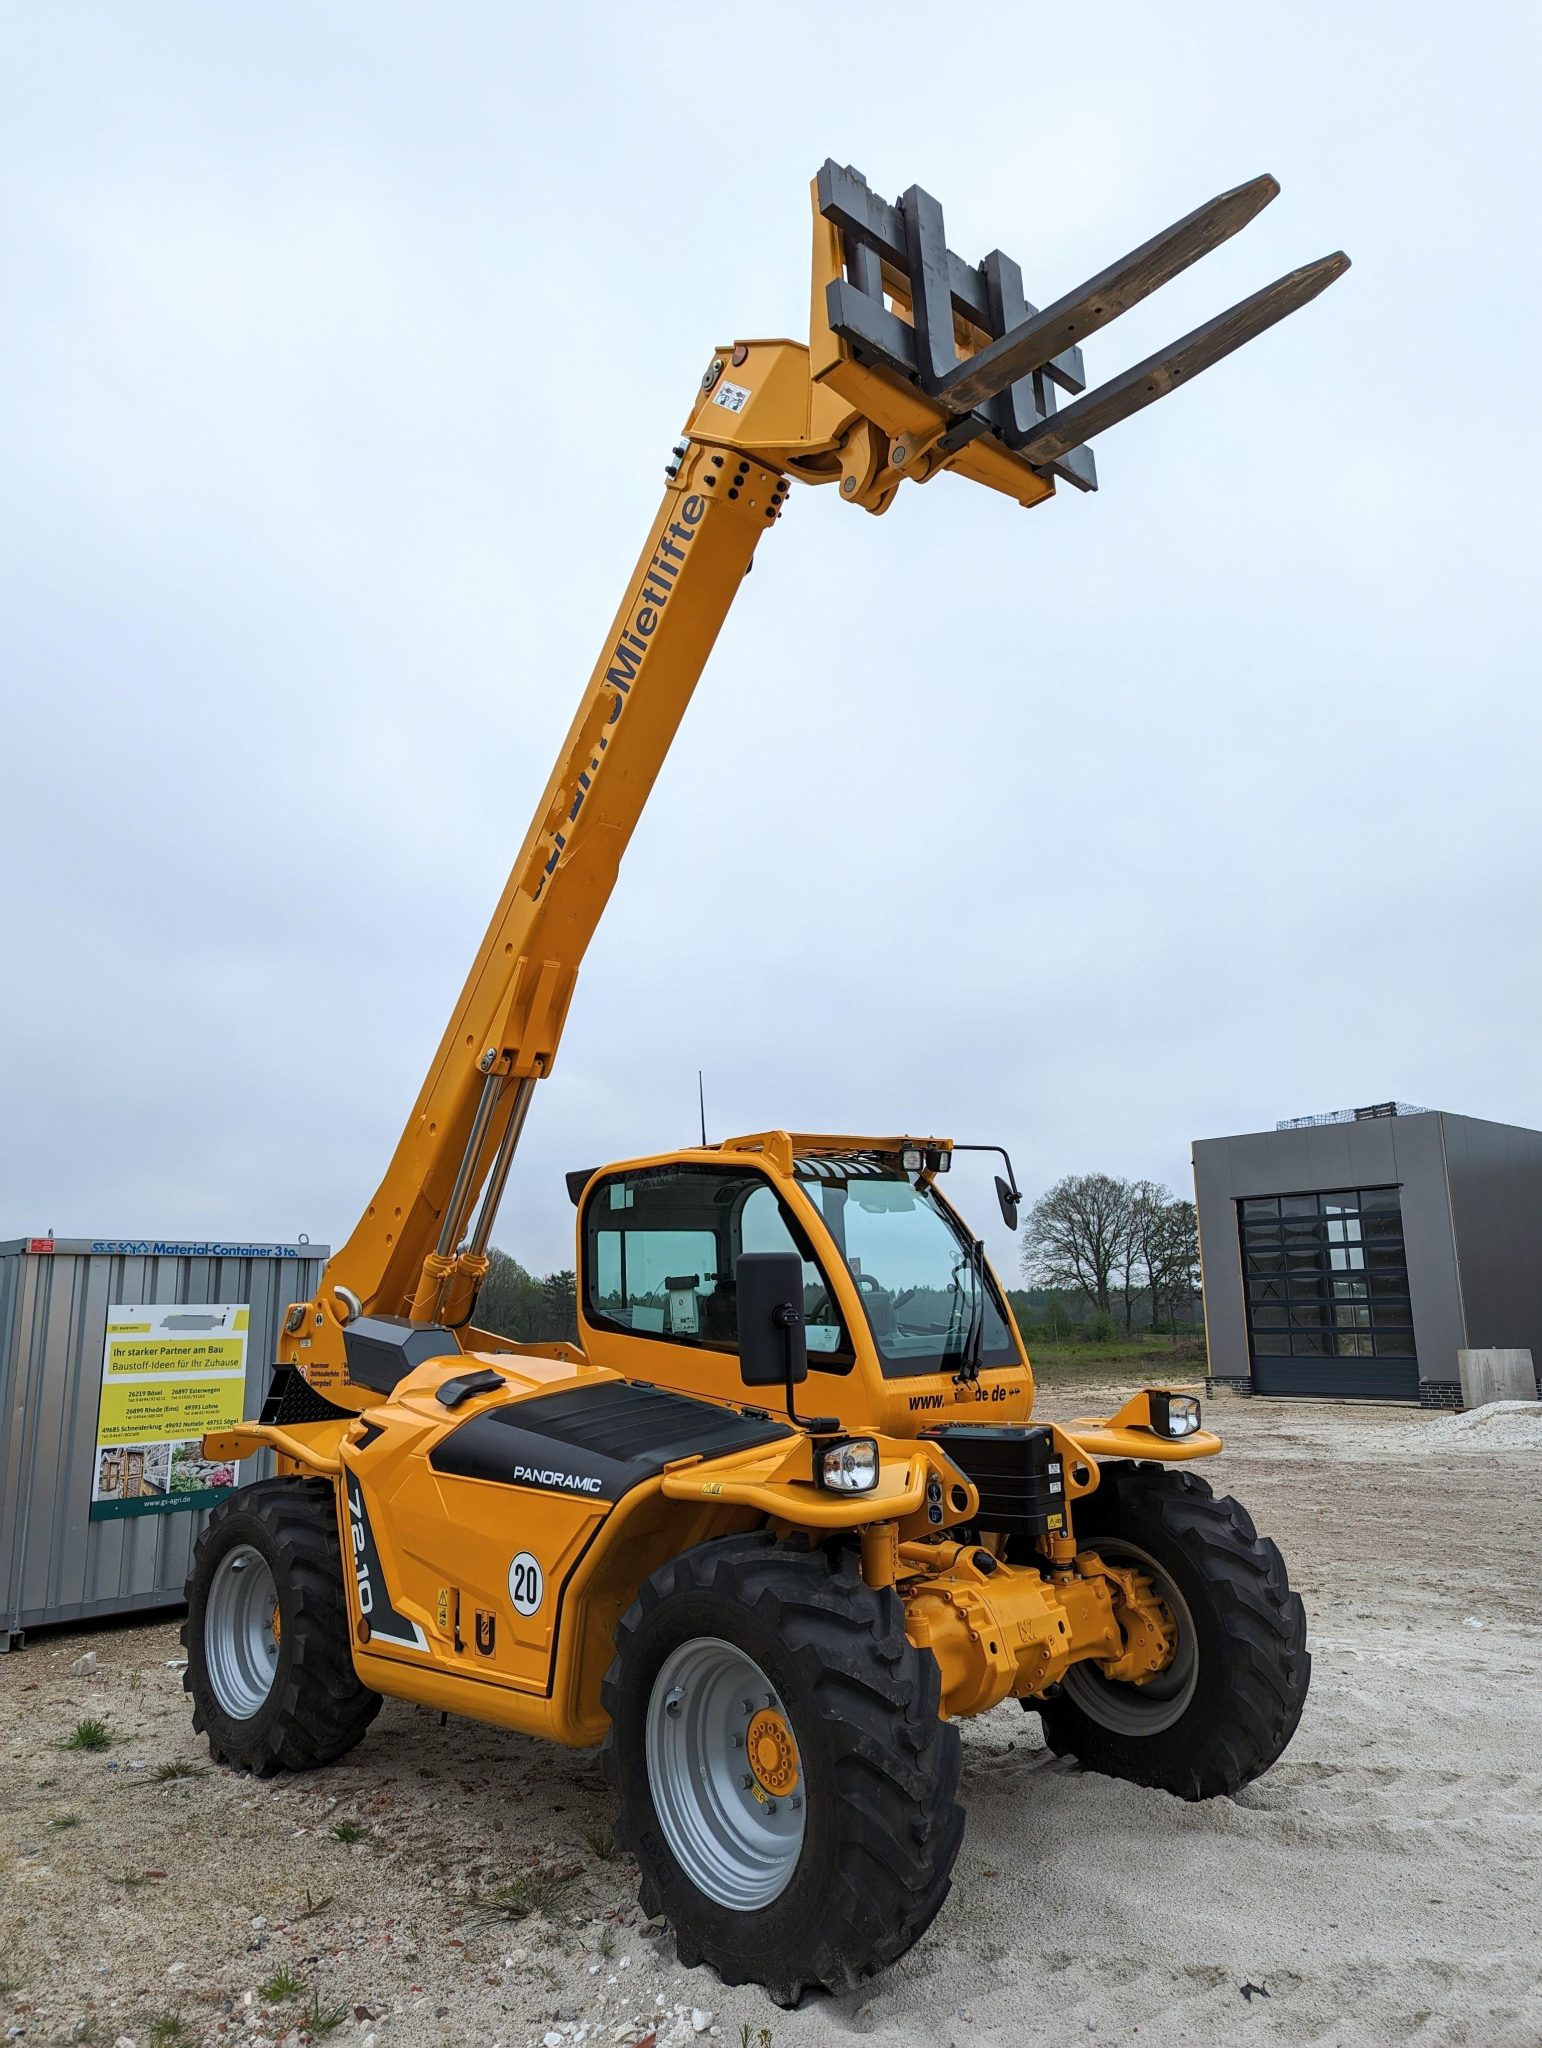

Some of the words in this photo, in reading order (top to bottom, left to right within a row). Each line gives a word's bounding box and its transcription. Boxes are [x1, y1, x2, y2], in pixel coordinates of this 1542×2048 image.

[152, 1243, 272, 1257] Material-Container
[274, 1246, 282, 1257] 3
[284, 1247, 298, 1257] to.
[113, 1348, 126, 1357] Ihr
[127, 1347, 158, 1356] starker
[160, 1346, 191, 1355] Partner
[208, 1345, 224, 1354] Bau
[112, 1360, 175, 1371] Baustoff-Ideen
[176, 1360, 189, 1368] für
[191, 1359, 202, 1368] Ihr
[204, 1359, 239, 1367] Zuhause
[120, 1424, 162, 1432] Schneiderkrug
[513, 1466, 602, 1492] PANORAMIC
[143, 1495, 191, 1507] www.gs-agri.de
[348, 1488, 374, 1614] 72.10
[514, 1563, 537, 1605] 20
